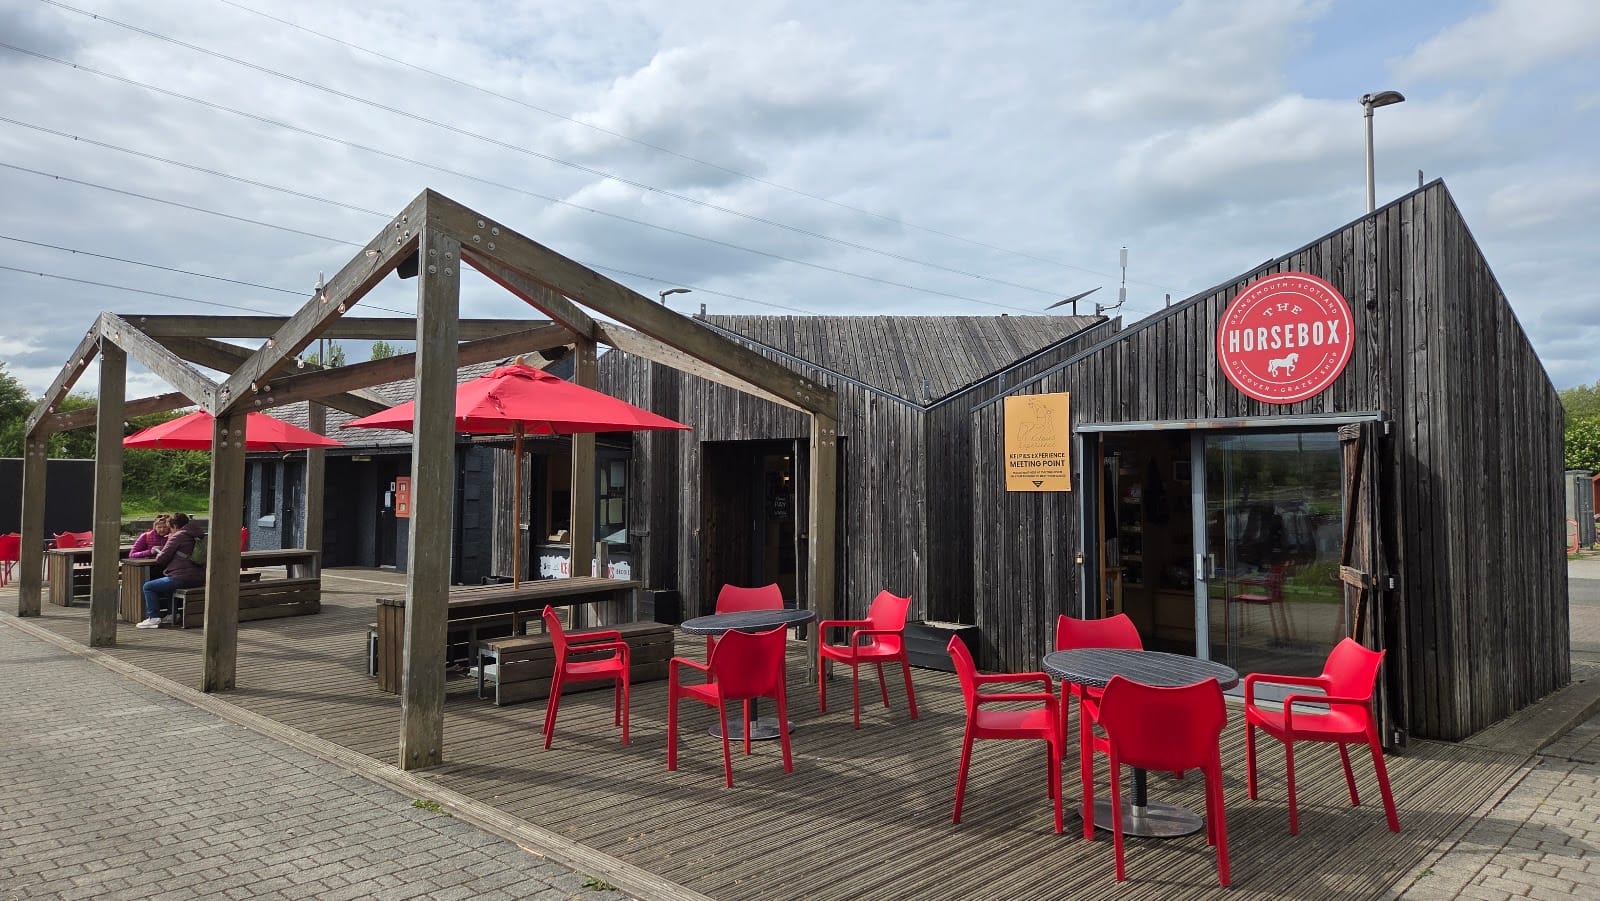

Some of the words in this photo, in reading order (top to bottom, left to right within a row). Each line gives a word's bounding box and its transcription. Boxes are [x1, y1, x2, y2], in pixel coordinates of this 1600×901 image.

[1231, 282, 1288, 325] GRANGEMOUTH
[1297, 283, 1337, 314] SCOTLAND
[1262, 302, 1302, 317] THE
[1229, 319, 1340, 353] HORSEBOX
[1232, 361, 1270, 392] DISCOVER
[1280, 379, 1313, 393] GRAZE
[1320, 352, 1337, 376] SHOP
[1009, 460, 1041, 468] MEETING
[1042, 459, 1065, 467] POINT
